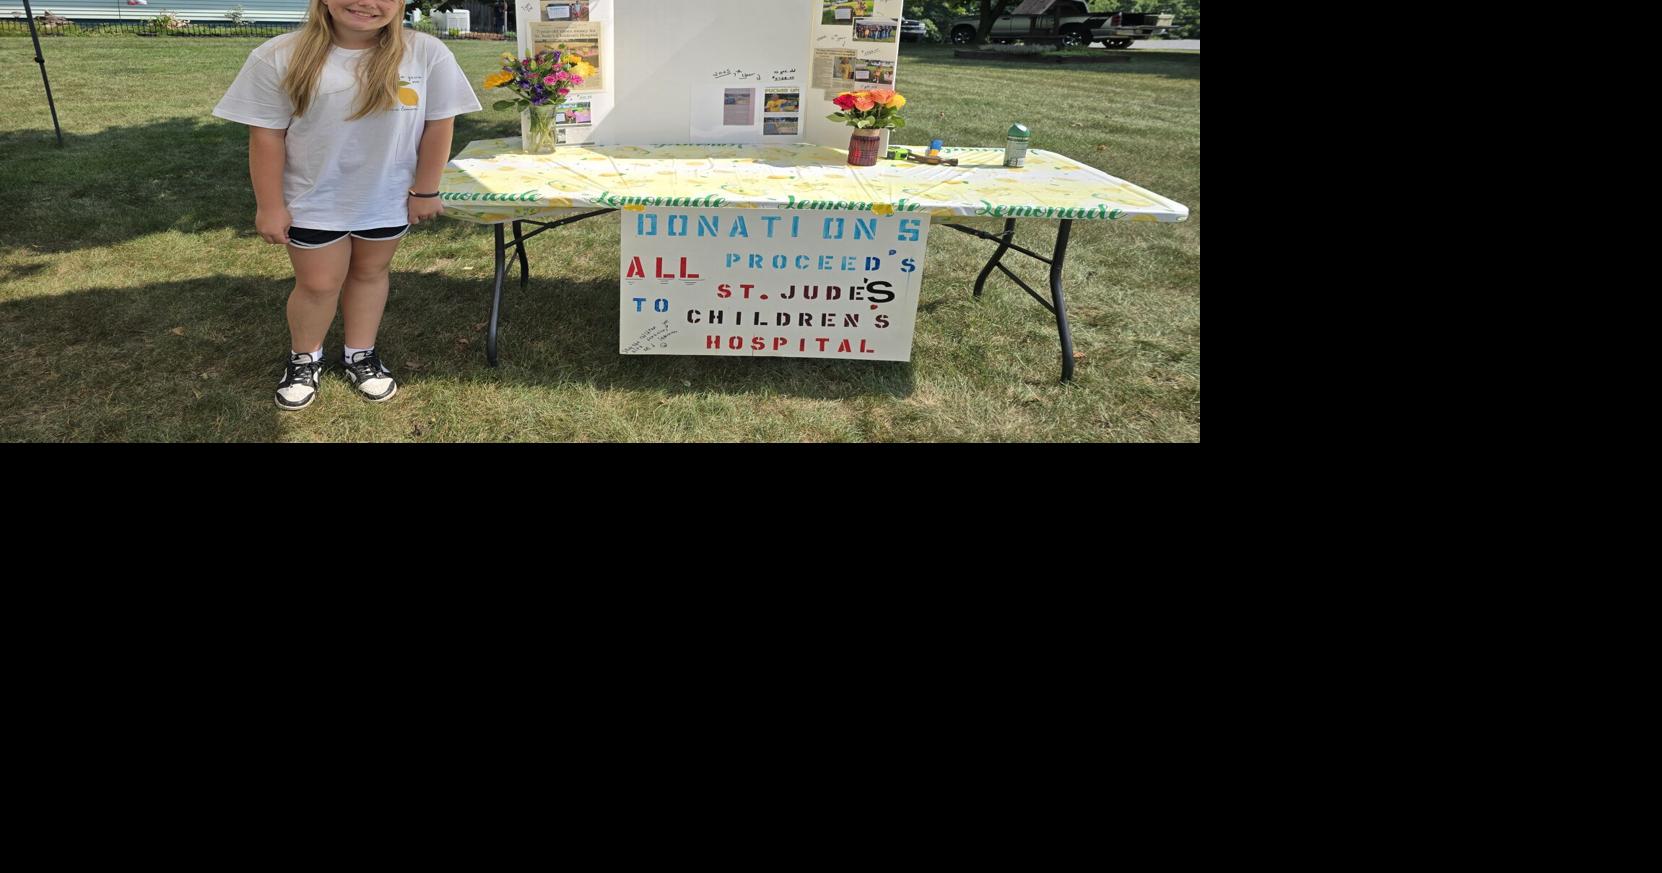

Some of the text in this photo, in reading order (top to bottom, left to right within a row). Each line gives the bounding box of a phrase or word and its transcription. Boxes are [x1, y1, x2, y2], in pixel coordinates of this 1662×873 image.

[589, 191, 730, 208] Lemonade
[975, 200, 1128, 219] Lemonade
[626, 256, 700, 279] ALL
[725, 249, 916, 273] PROCEED'S
[717, 277, 896, 303] ST. JUDE'S
[632, 298, 669, 313] TO
[686, 304, 890, 329] CHILDREN'S
[706, 335, 875, 354] HOSPITAL
